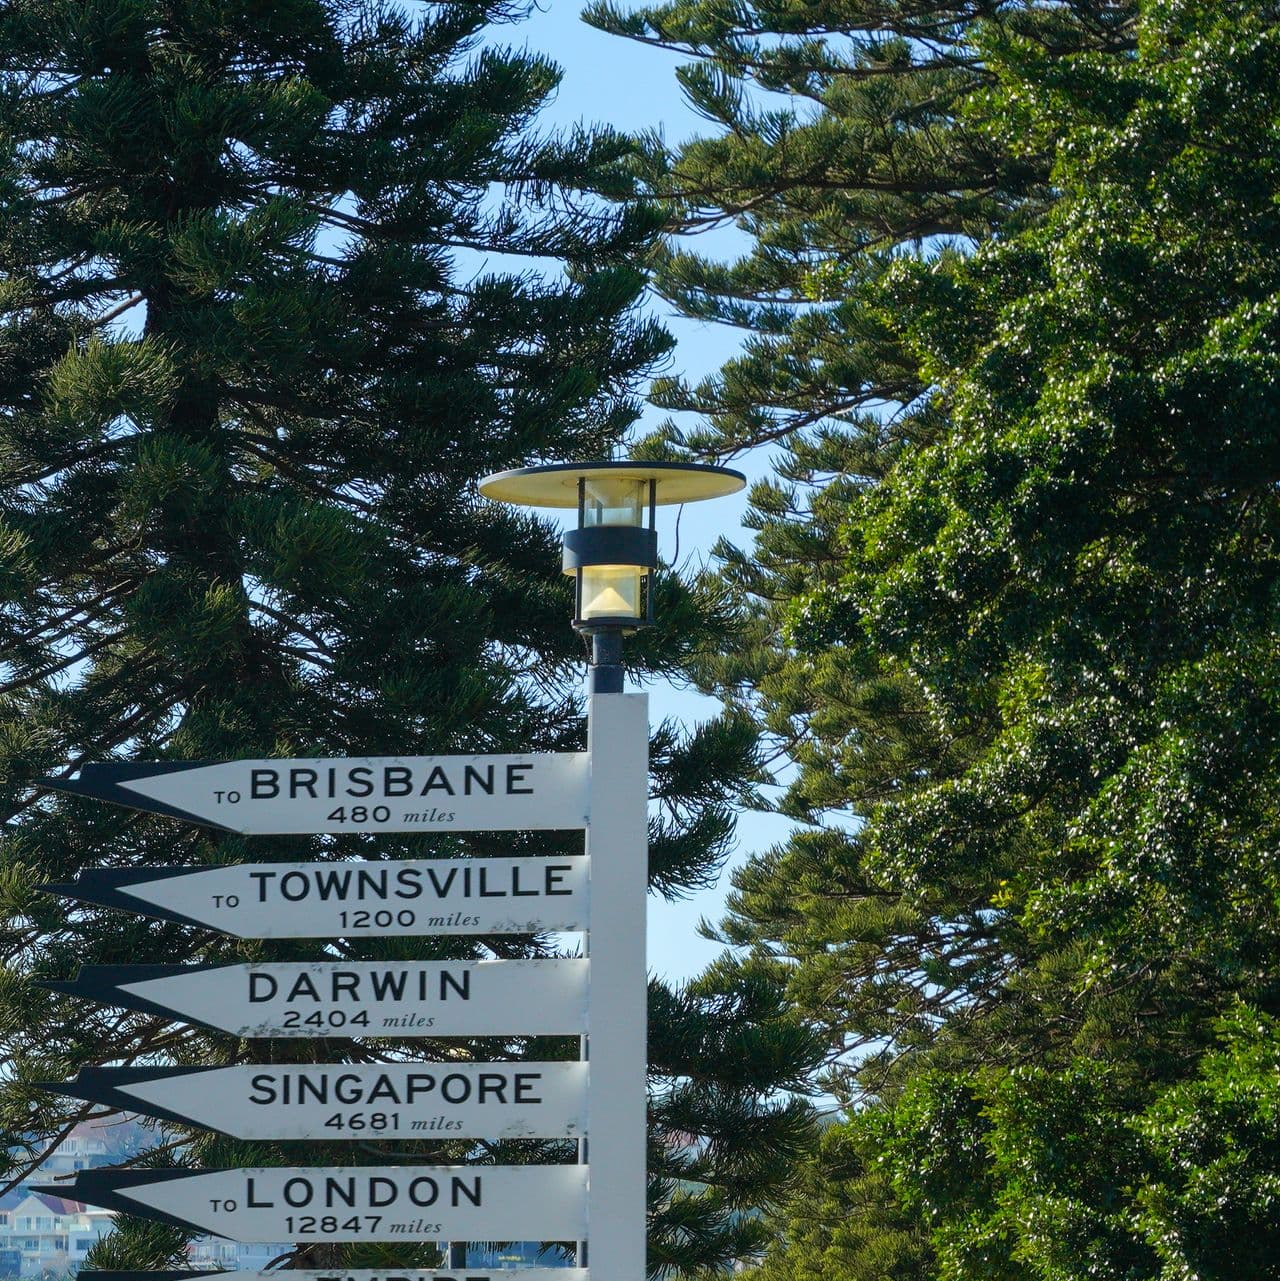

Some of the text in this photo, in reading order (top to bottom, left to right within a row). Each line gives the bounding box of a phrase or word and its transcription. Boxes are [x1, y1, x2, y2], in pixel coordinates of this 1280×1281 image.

[213, 763, 534, 805] TO BRISBANE
[326, 805, 456, 824] 480 miles
[211, 862, 573, 909] TO TOWNSVILLE
[339, 909, 481, 929] 1200 miles
[248, 967, 470, 1003] DARWIN
[281, 1009, 436, 1029] 2404 miles
[248, 1073, 542, 1106] SINGAPORE
[324, 1112, 464, 1131] 4681 miles
[209, 1176, 482, 1213] TO LONDON
[285, 1215, 442, 1234] 12847 miles
